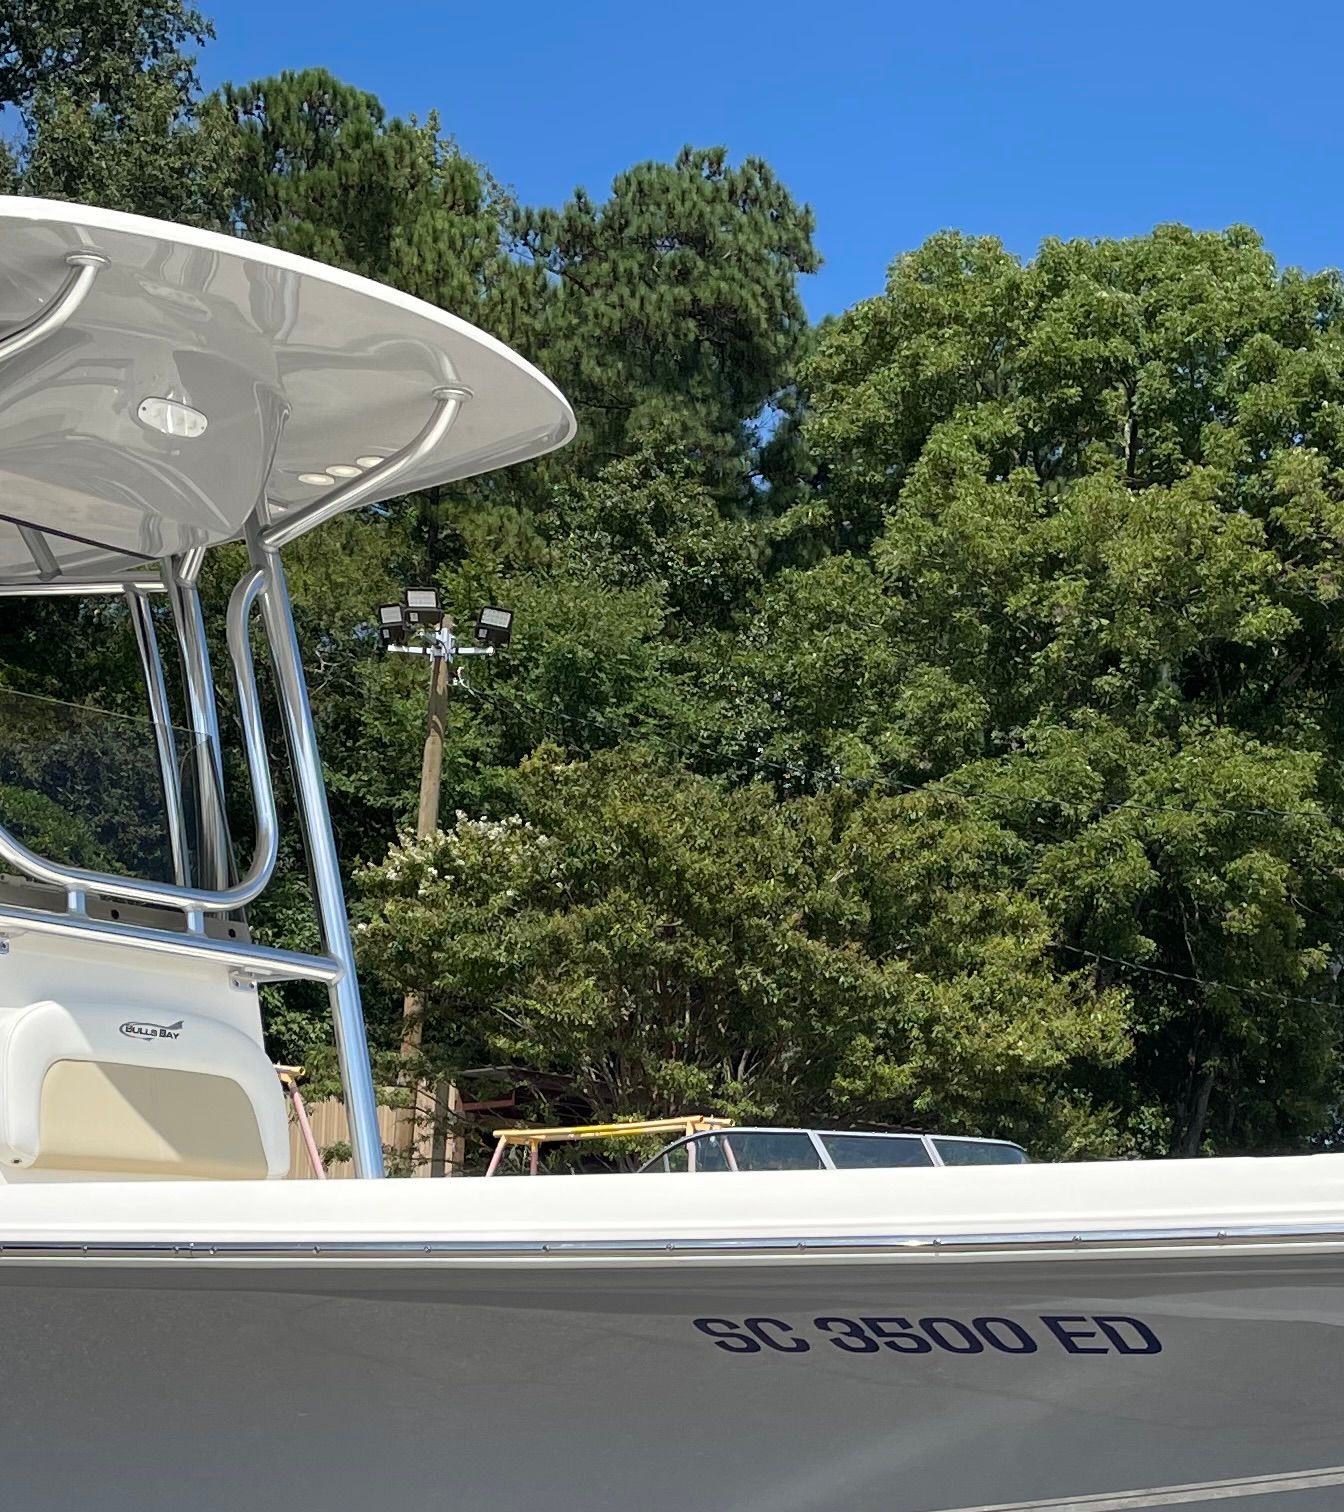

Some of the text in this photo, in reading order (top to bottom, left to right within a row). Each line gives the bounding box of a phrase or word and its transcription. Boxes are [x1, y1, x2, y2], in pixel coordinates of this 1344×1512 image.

[125, 1025, 181, 1040] BULLS BAY
[692, 1315, 1163, 1355] SC 3500 ED
